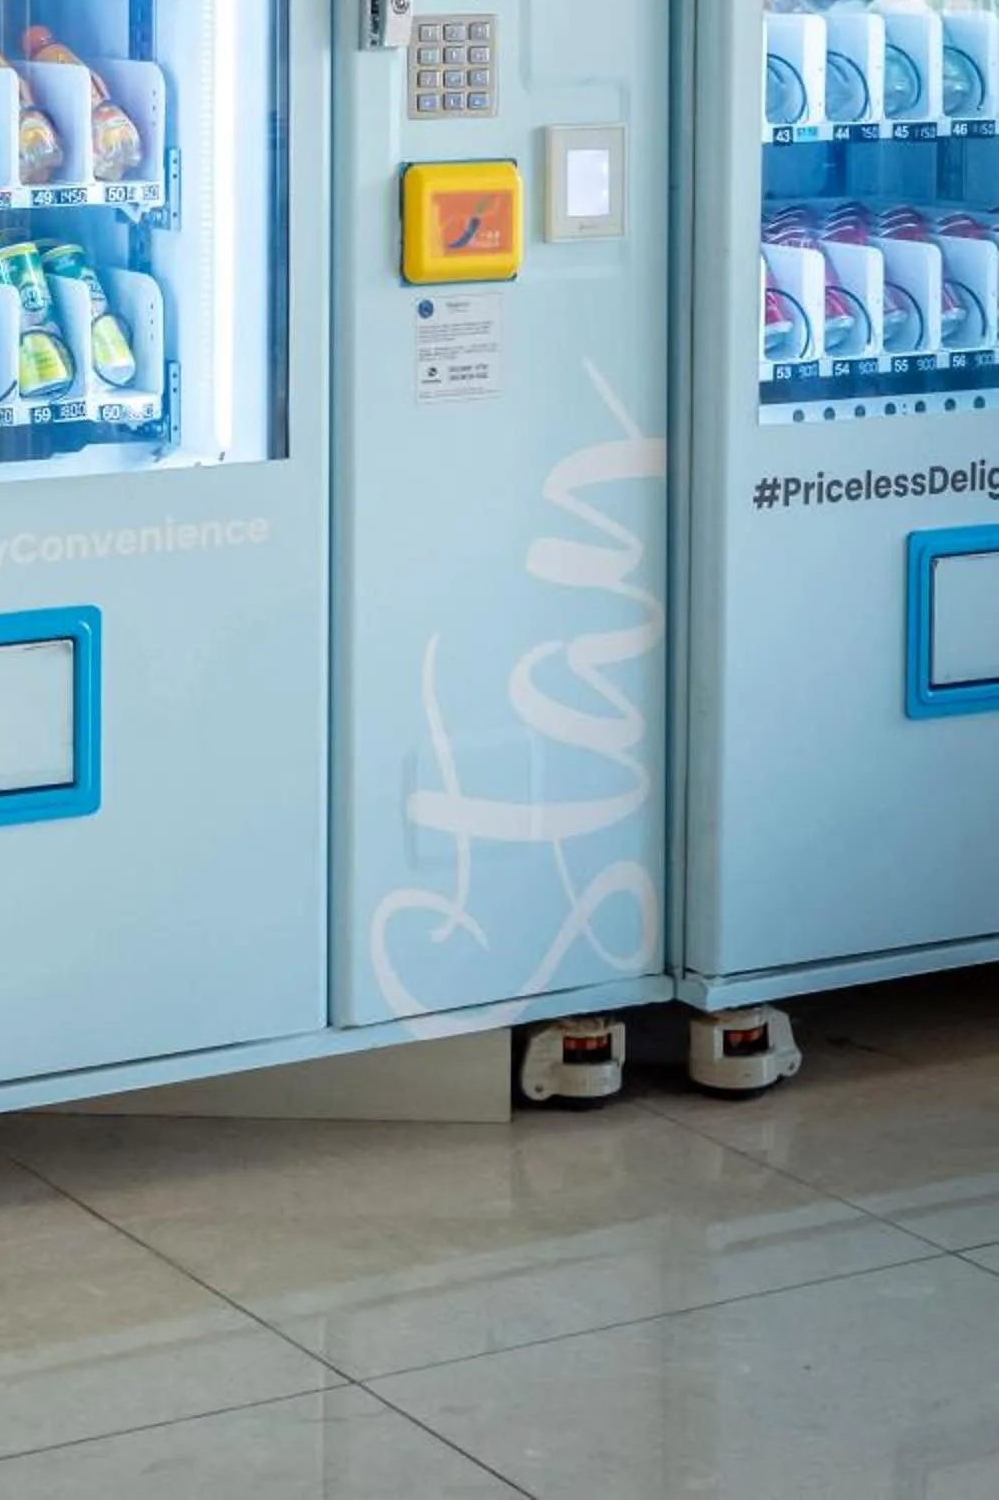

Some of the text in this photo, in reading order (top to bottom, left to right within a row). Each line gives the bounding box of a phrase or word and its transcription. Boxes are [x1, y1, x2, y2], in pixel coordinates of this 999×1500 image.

[776, 129, 789, 143] 43
[895, 125, 910, 139] 45
[953, 123, 968, 136] 46
[34, 190, 51, 204] 49
[835, 363, 850, 376] 54
[894, 359, 909, 372] 55
[33, 407, 51, 422] 59
